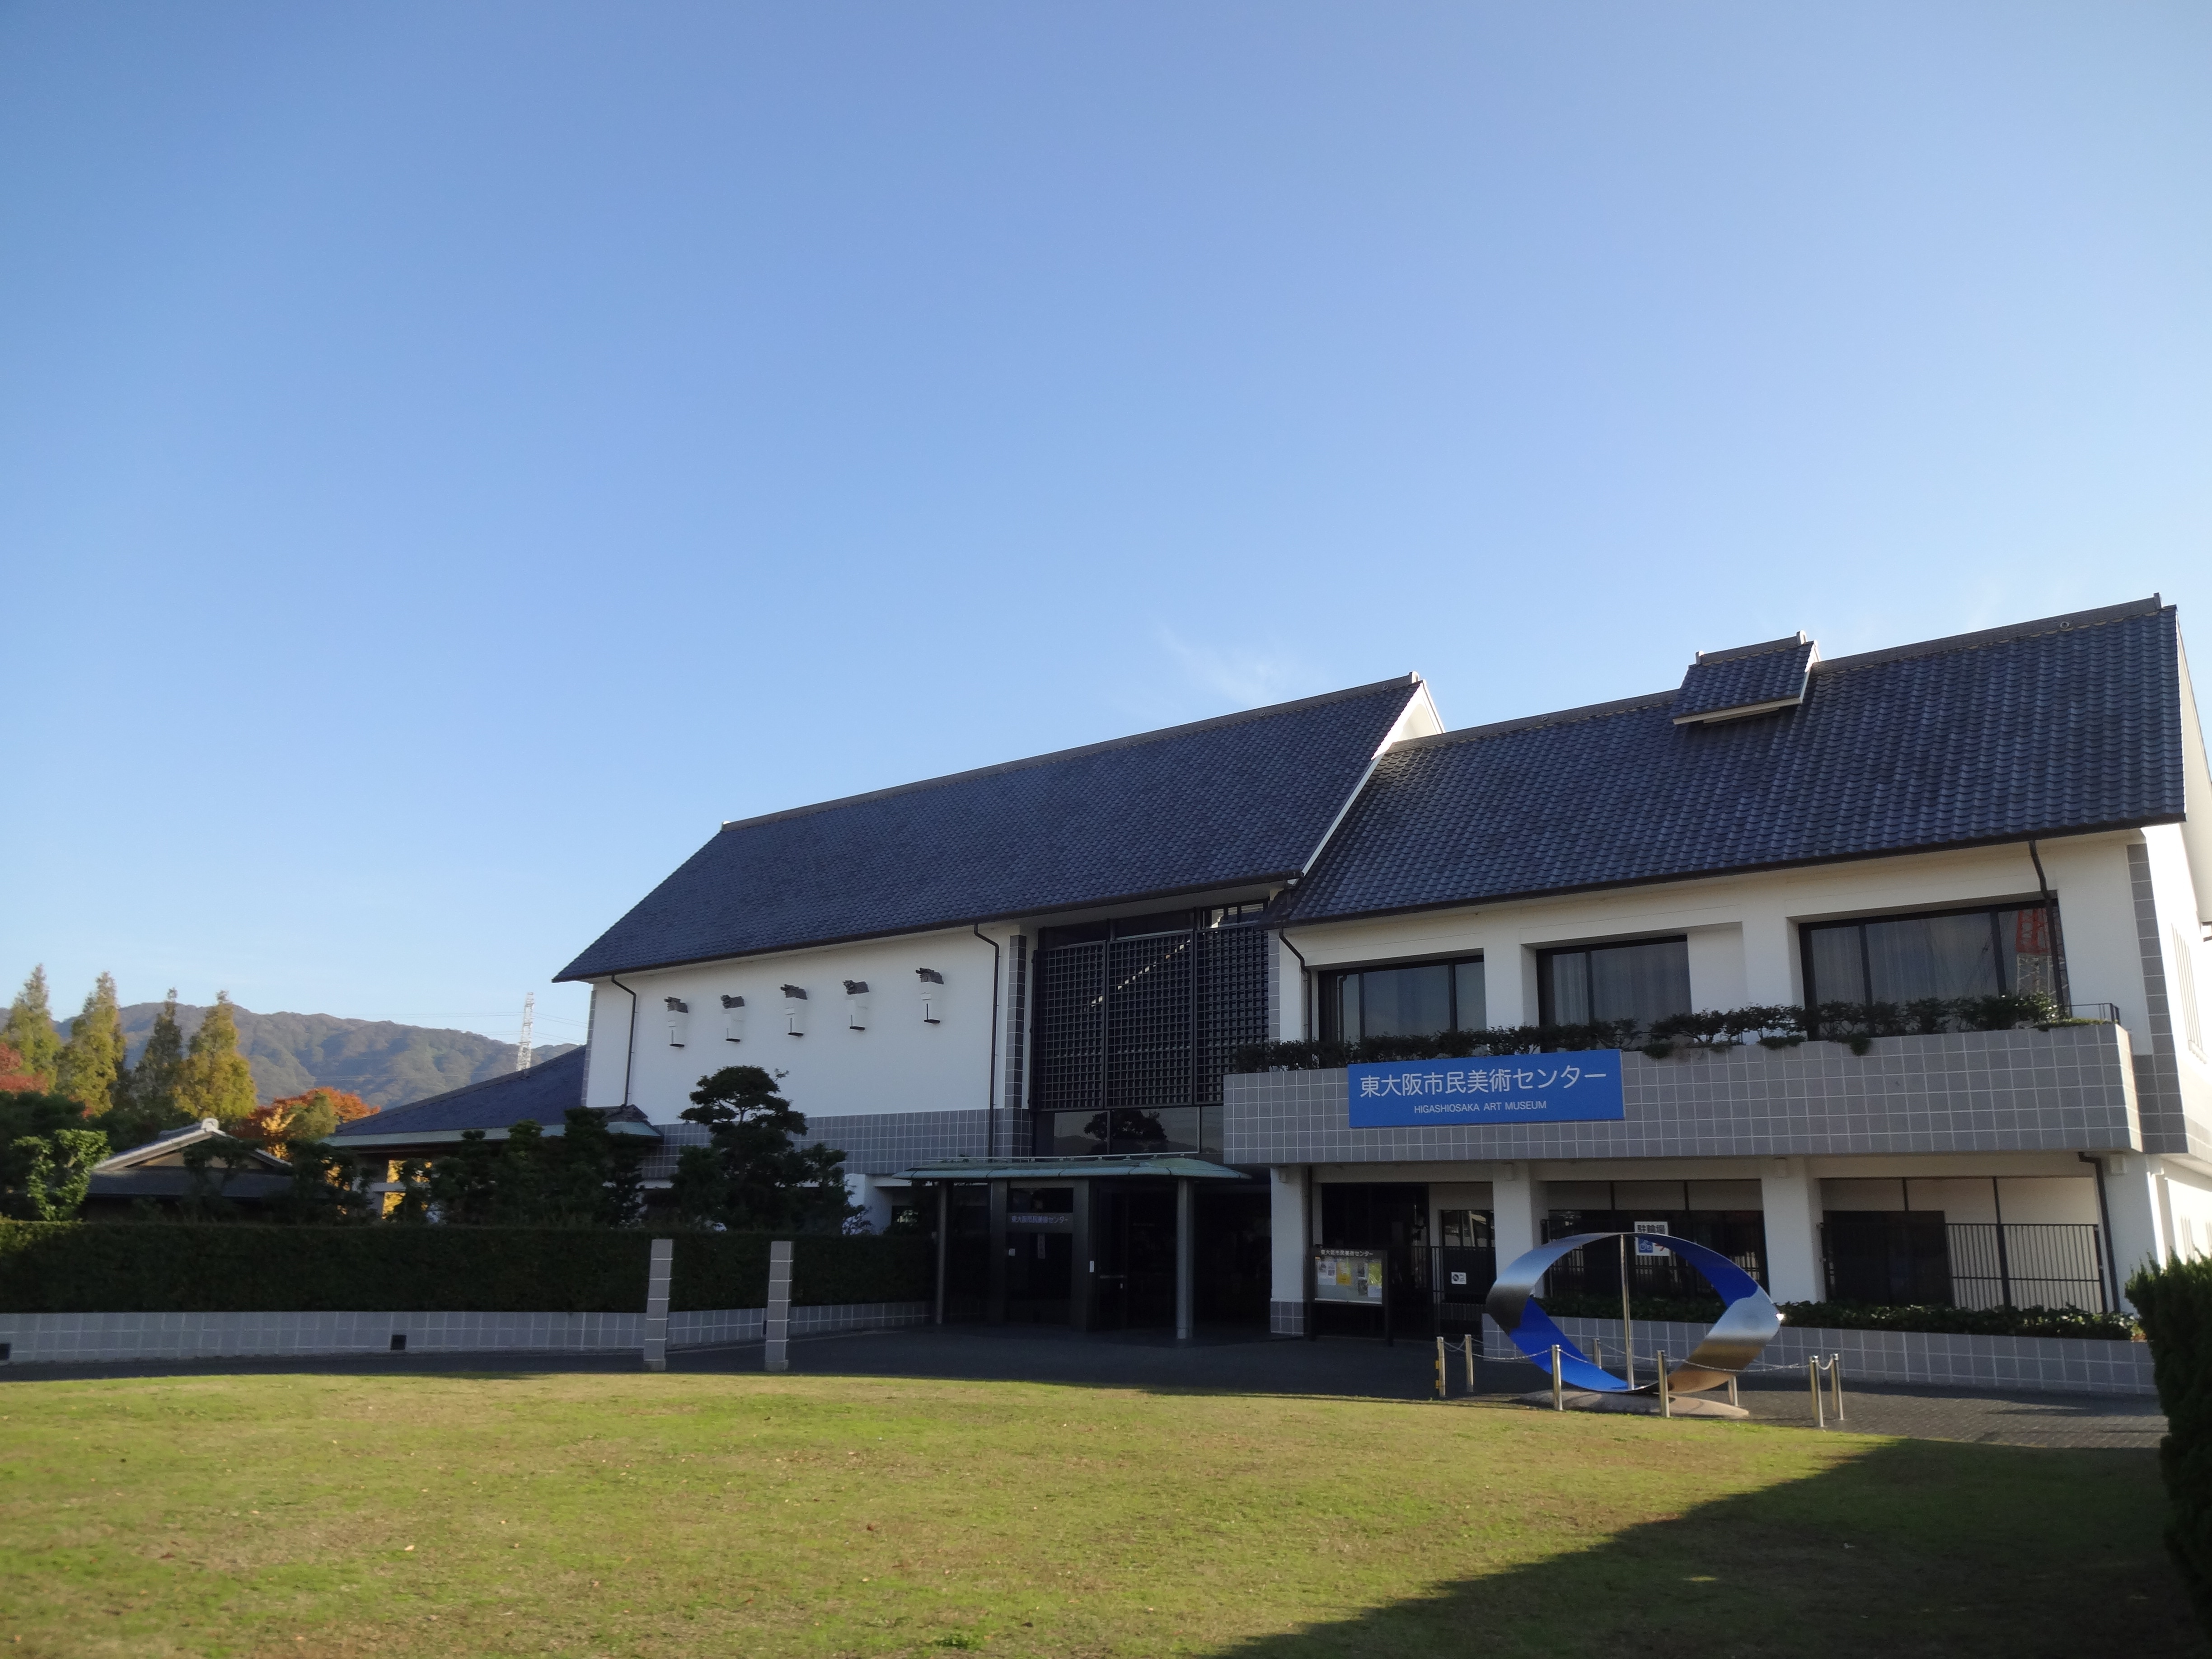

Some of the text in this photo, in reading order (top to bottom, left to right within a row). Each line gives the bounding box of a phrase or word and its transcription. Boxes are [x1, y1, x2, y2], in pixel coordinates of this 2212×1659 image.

[1360, 1065, 1606, 1097] 東大阪市民美術センター
[1415, 1101, 1547, 1113] HIGASHIOSAKA ART MUSEUM
